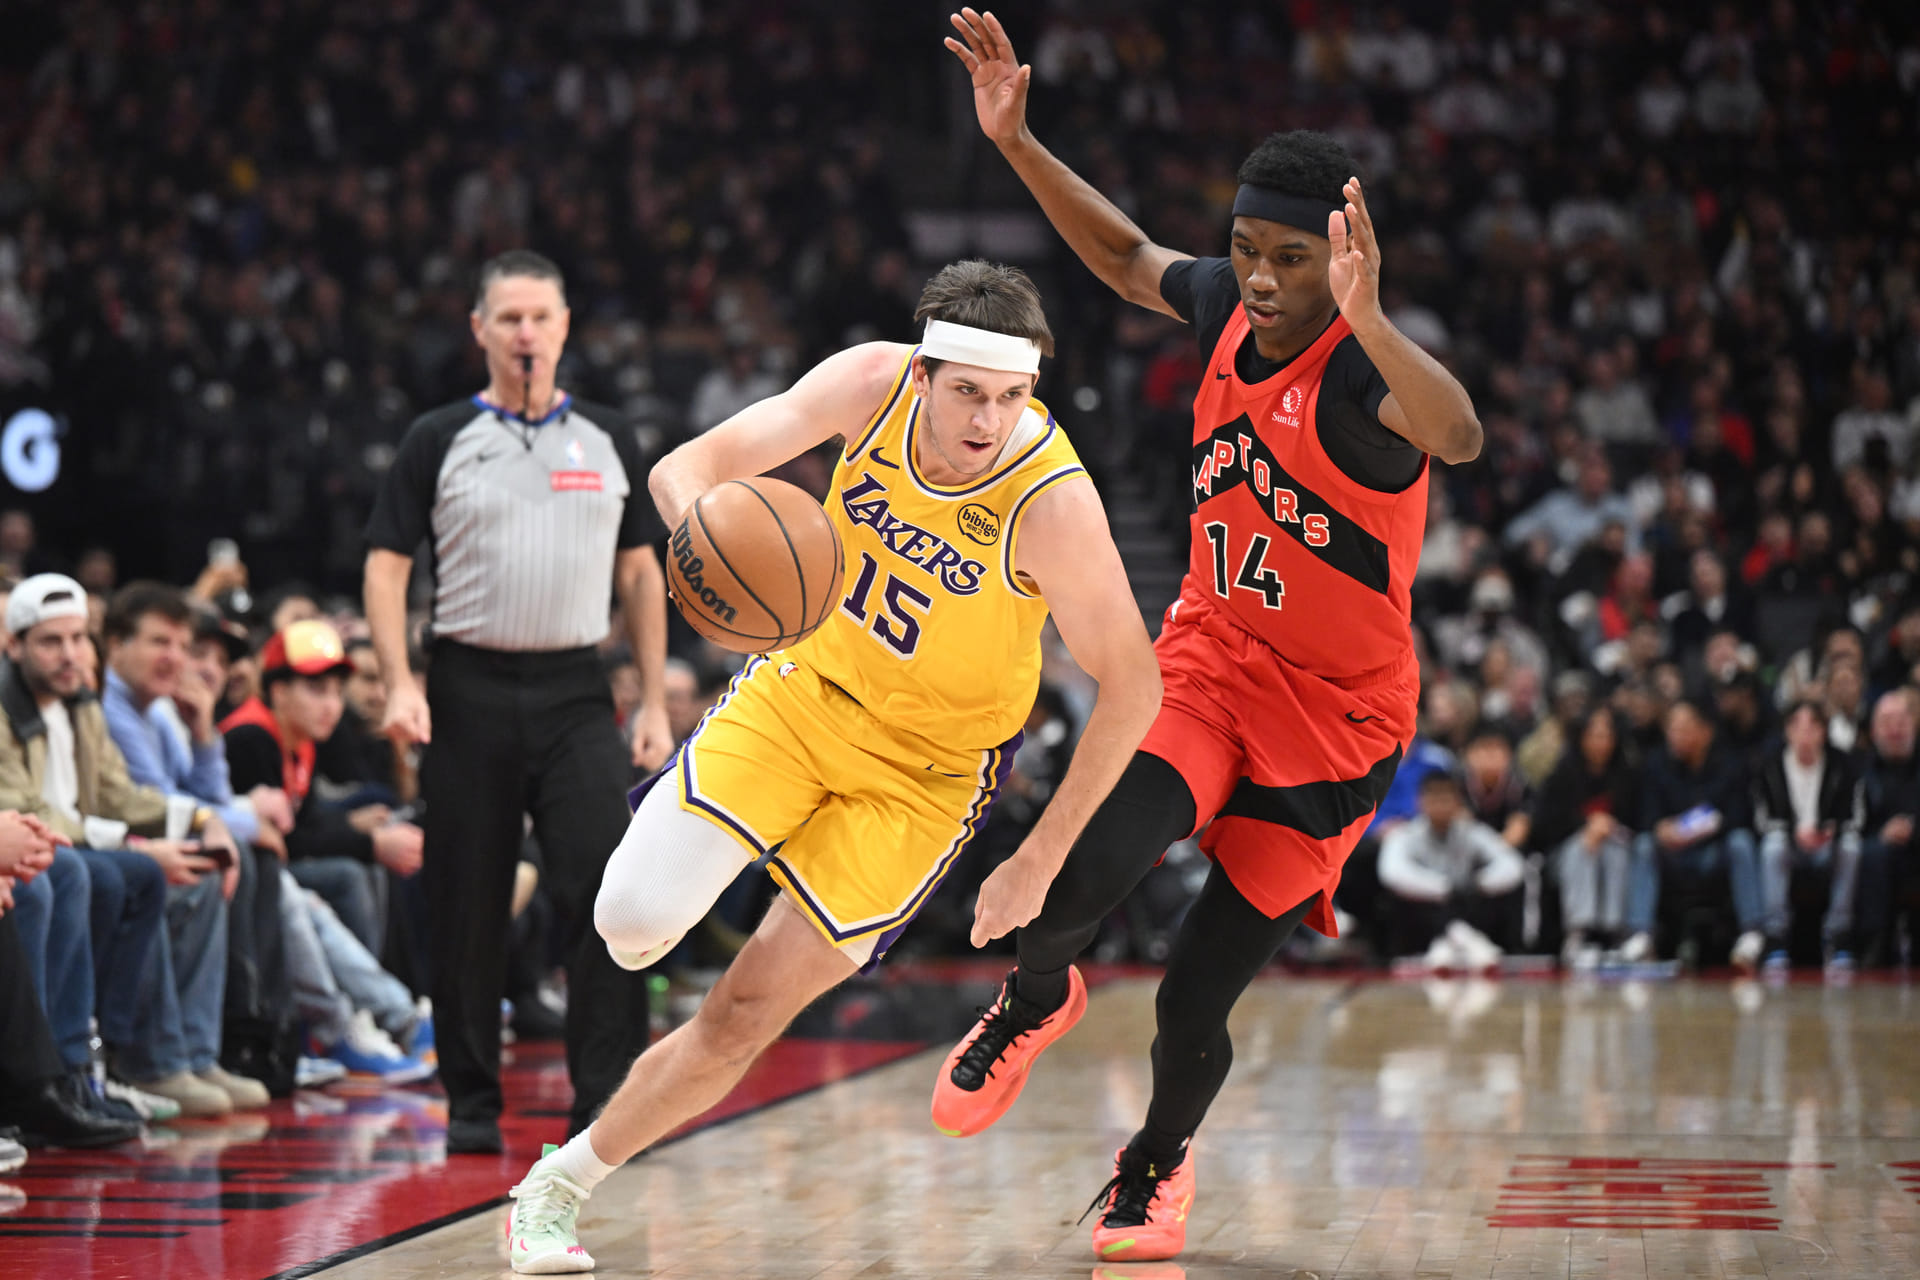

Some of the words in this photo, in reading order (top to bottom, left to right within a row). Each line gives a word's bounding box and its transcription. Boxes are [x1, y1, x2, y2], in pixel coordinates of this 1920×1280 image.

[1272, 411, 1288, 425] Sun
[1287, 416, 1301, 429] Life
[841, 471, 989, 597] LAKERS
[962, 508, 998, 537] bibigo
[1193, 432, 1330, 547] APTORS
[672, 516, 738, 625] Wilson
[838, 549, 934, 661] 15
[1203, 520, 1285, 611] 14
